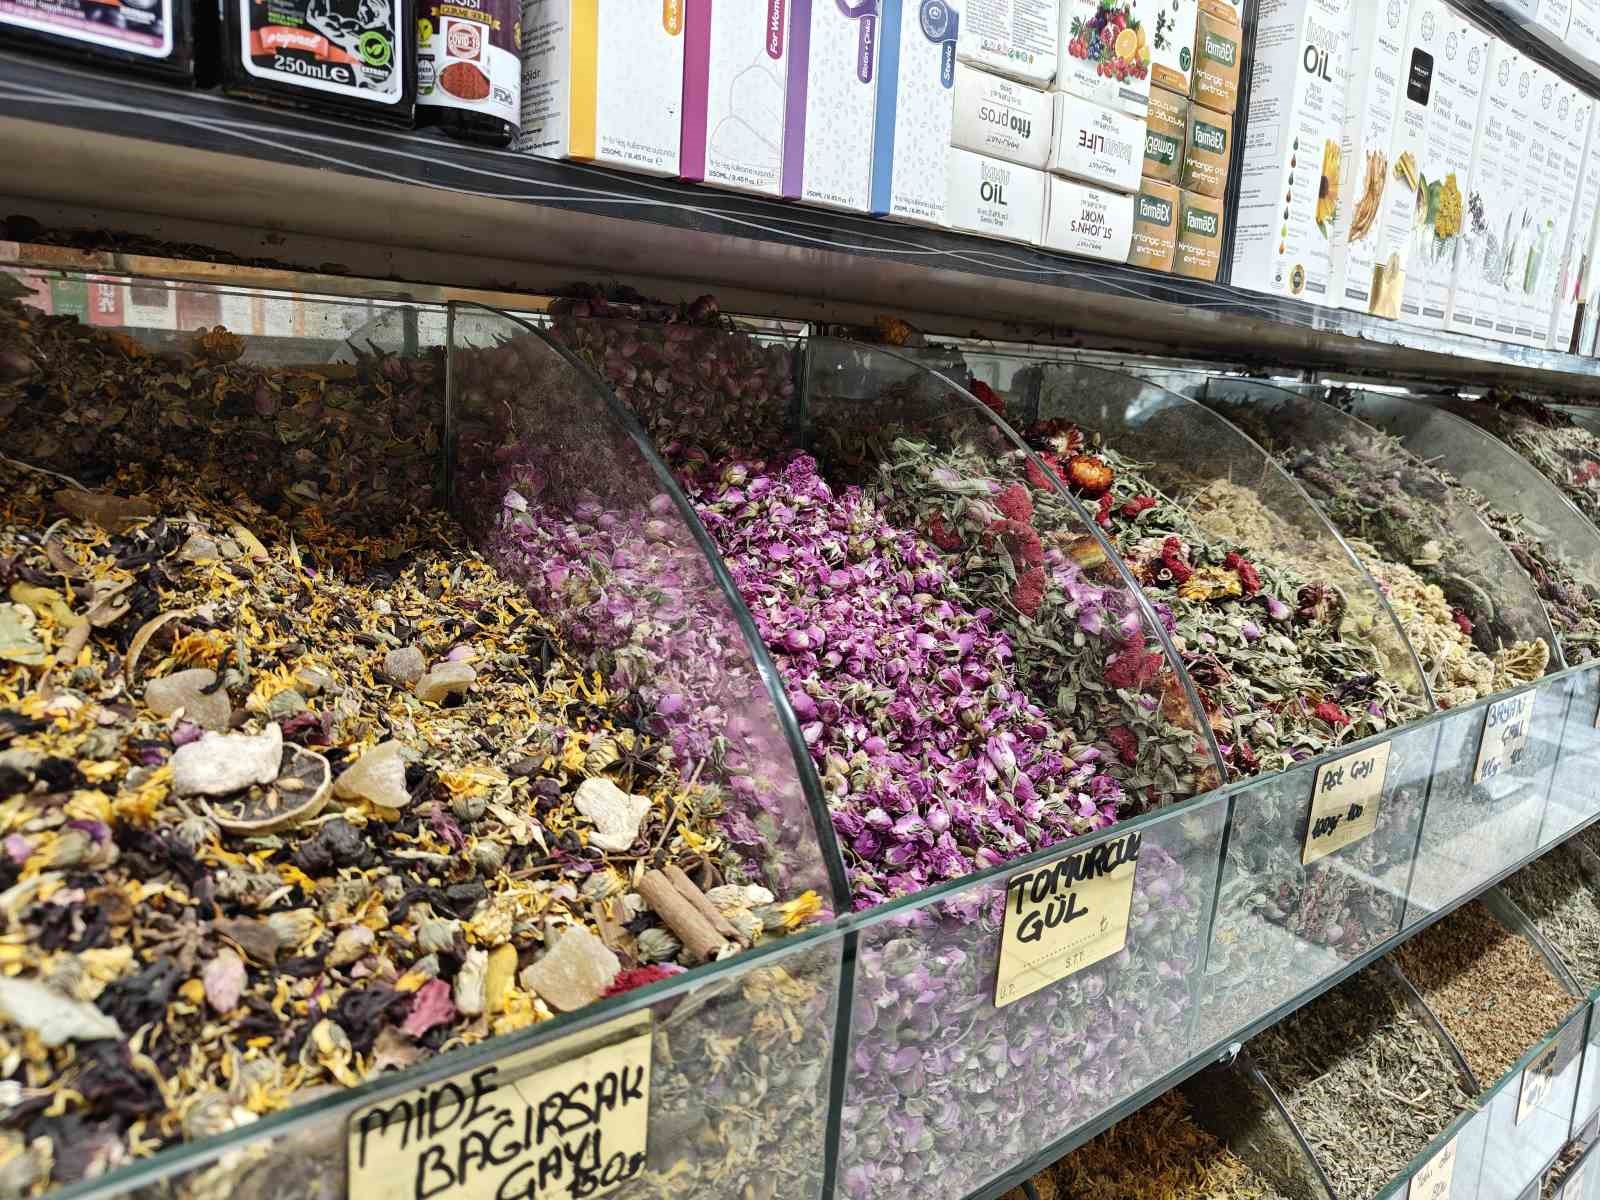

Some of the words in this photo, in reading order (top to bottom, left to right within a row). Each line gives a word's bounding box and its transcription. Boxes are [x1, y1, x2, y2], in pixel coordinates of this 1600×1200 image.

[770, 0, 781, 31] Wom
[769, 33, 779, 54] For
[1010, 115, 1031, 139] fito
[1016, 892, 1089, 943] GÜL
